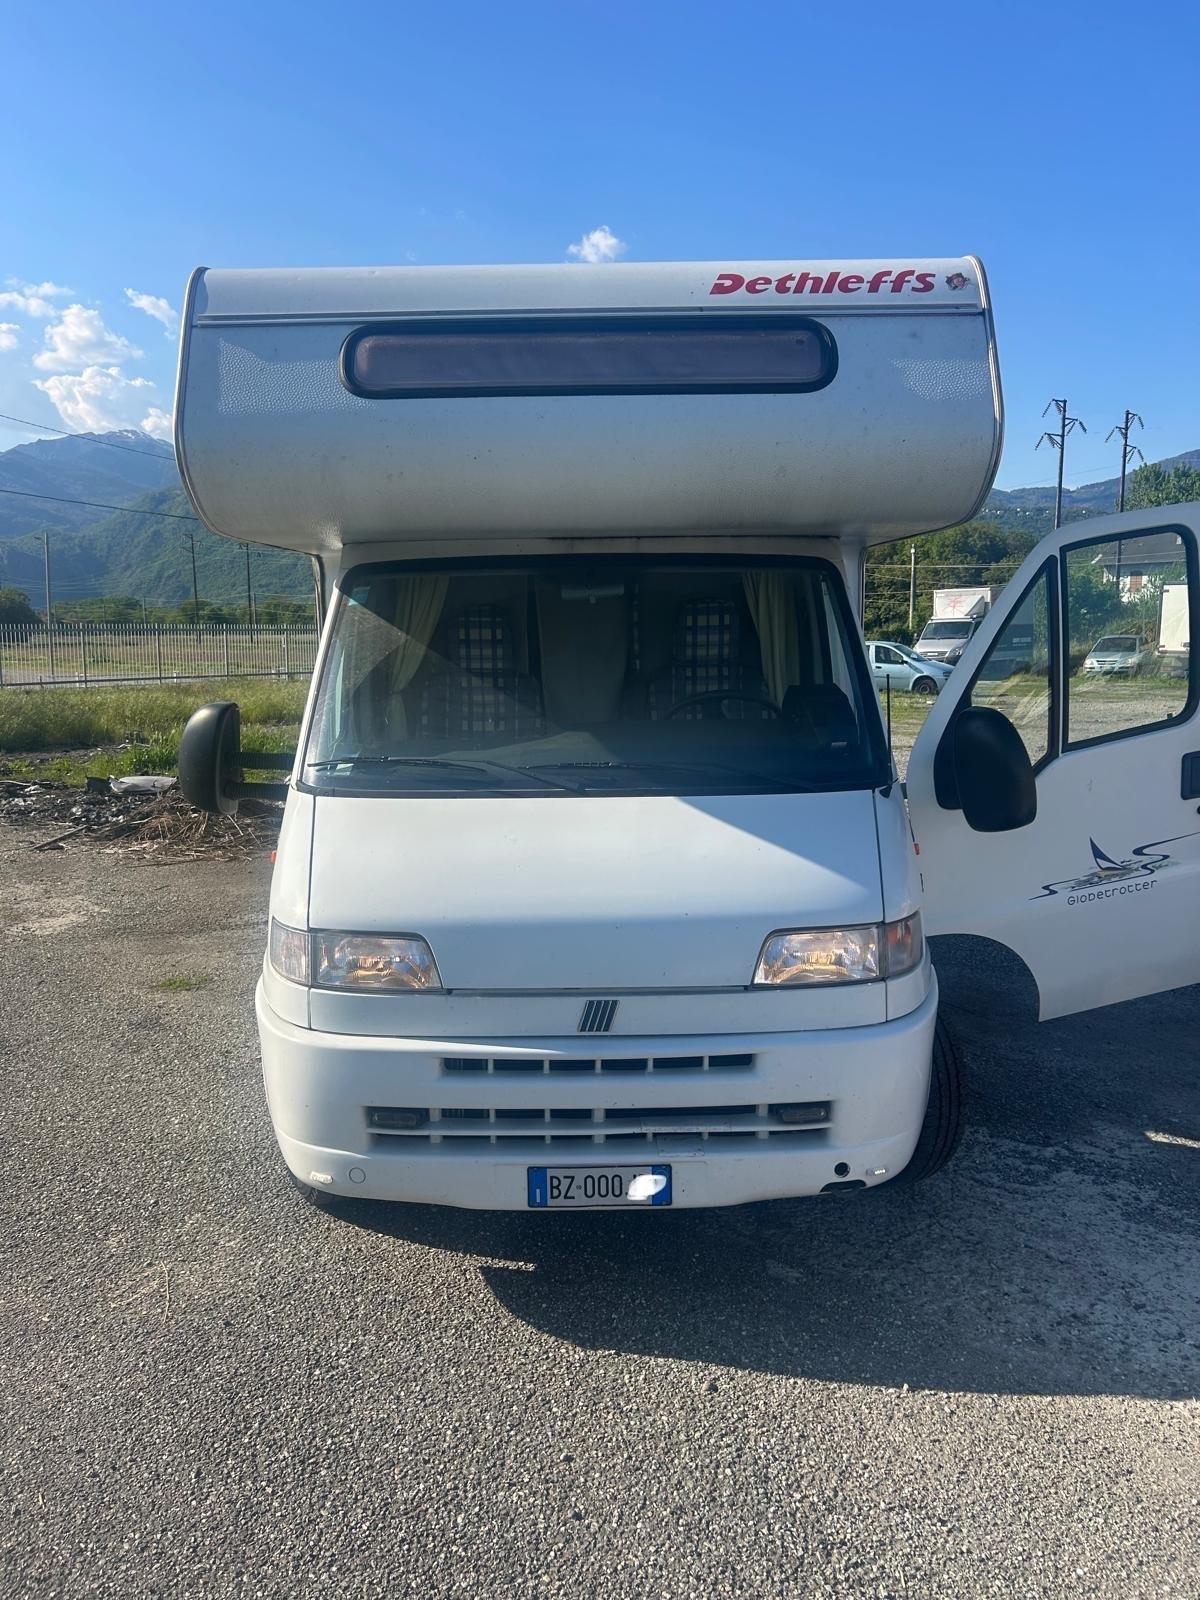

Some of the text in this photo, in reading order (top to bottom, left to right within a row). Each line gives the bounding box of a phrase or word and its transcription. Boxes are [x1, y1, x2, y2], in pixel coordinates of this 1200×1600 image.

[710, 270, 936, 295] Dethleffs
[1067, 879, 1157, 906] Globetrotter
[550, 1175, 575, 1200] BZ
